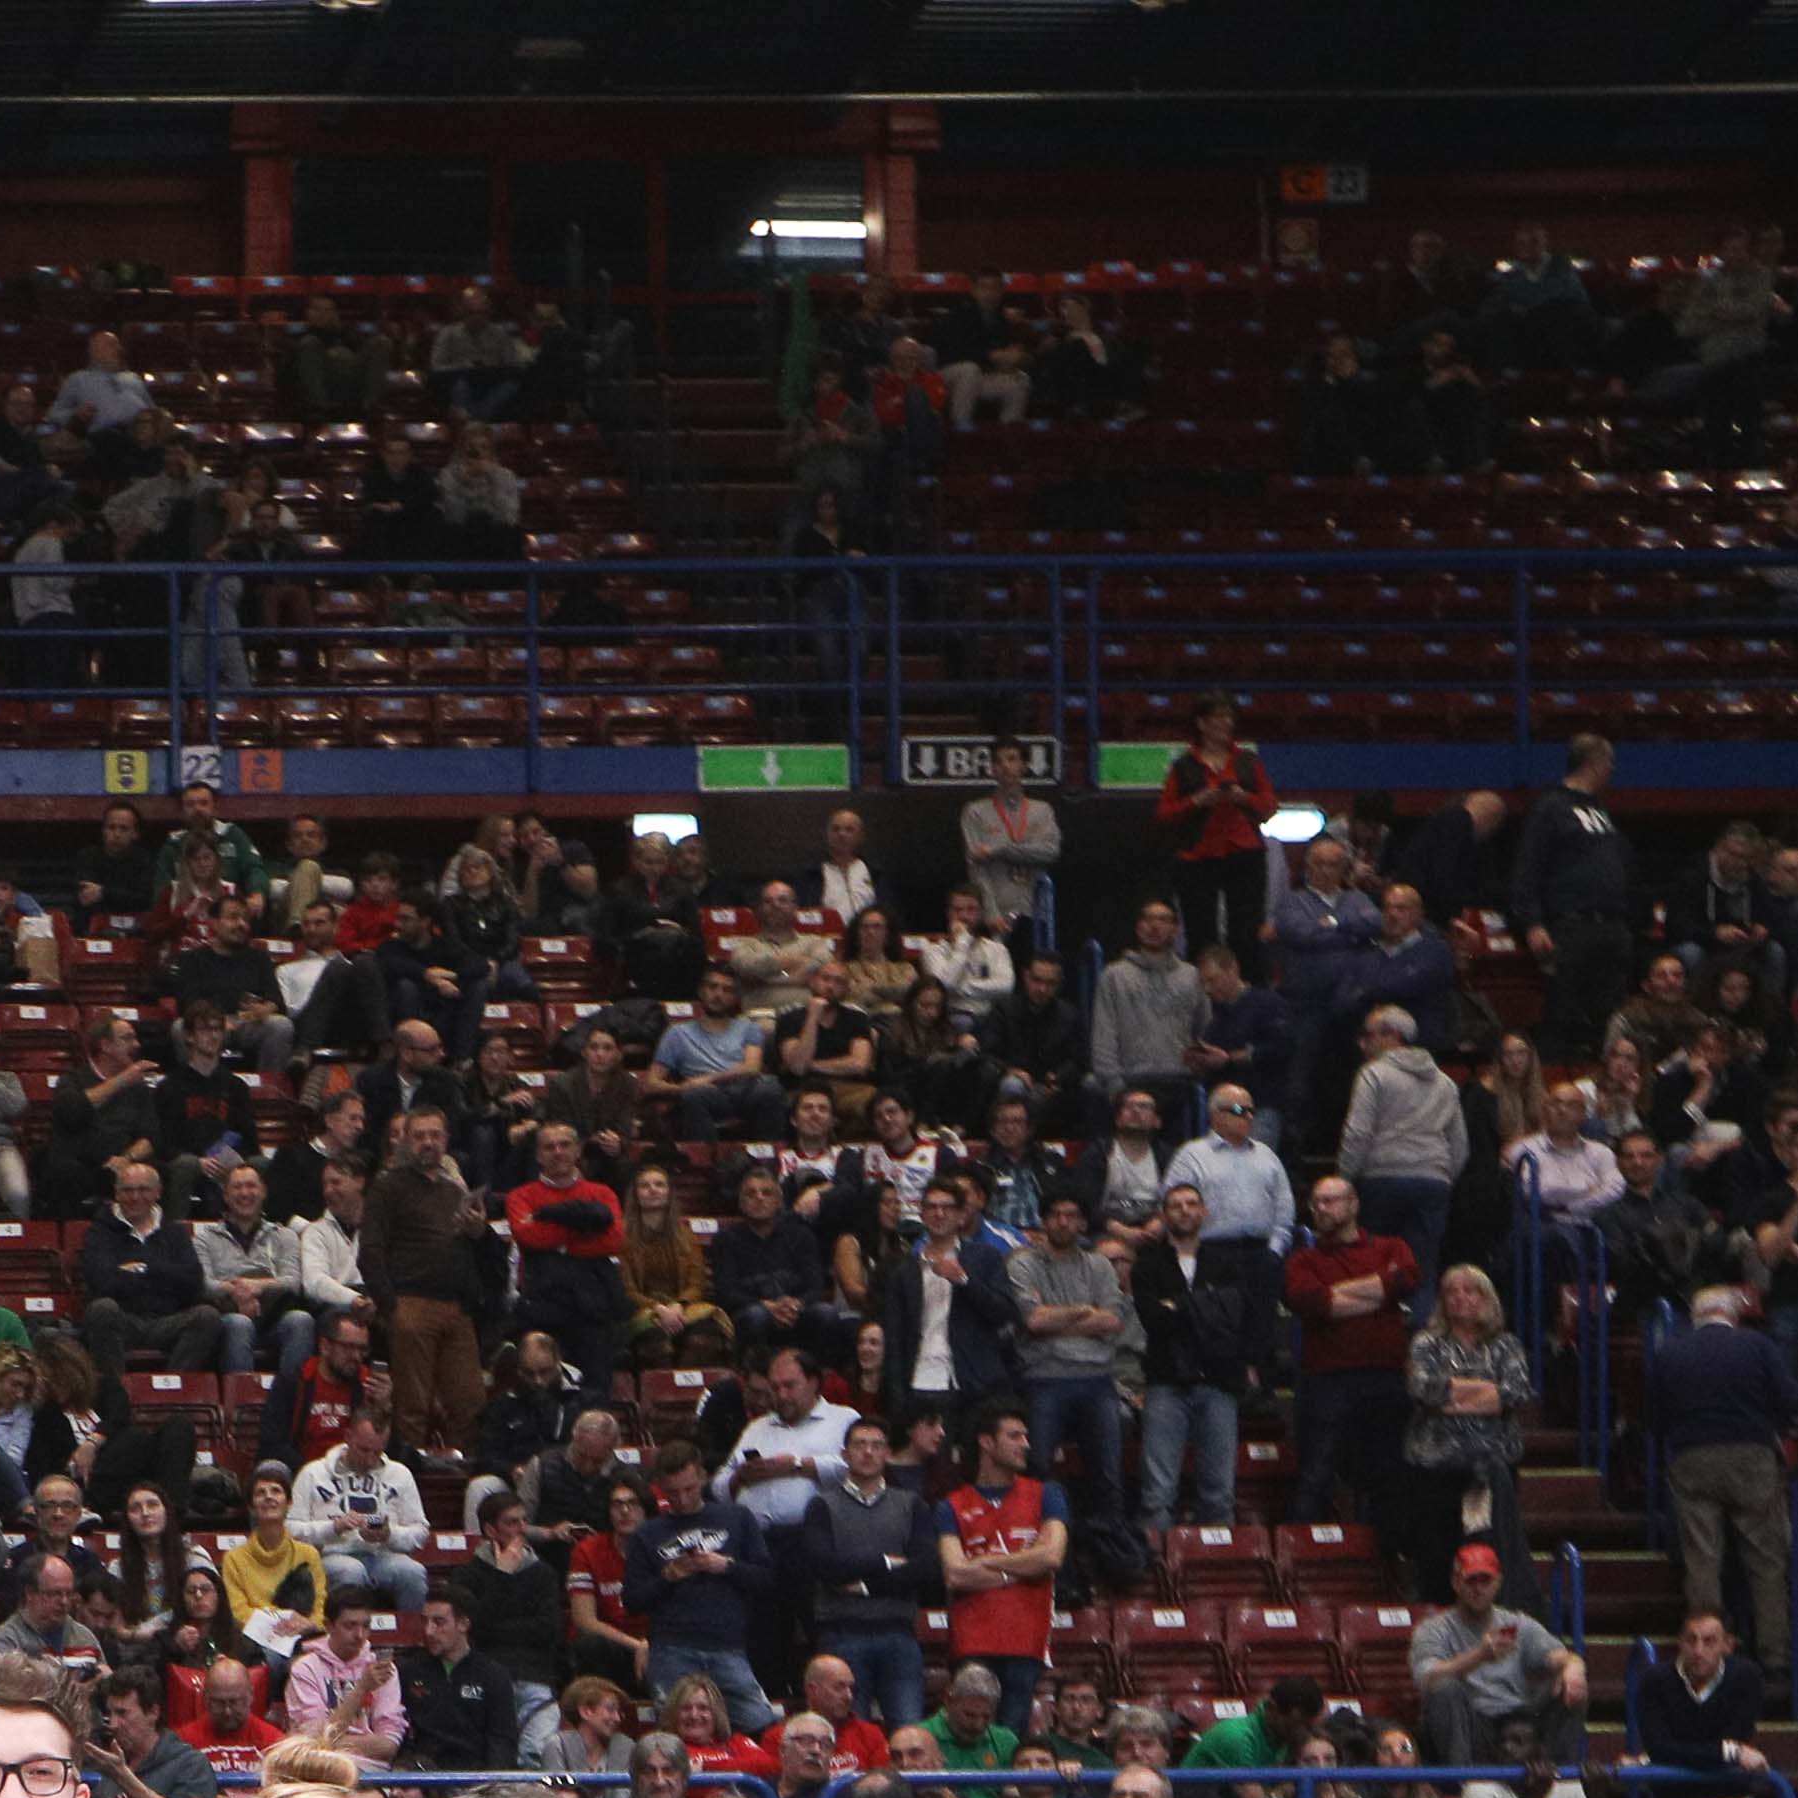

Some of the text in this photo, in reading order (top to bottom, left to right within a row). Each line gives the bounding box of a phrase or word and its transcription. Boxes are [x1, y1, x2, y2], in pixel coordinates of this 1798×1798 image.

[118, 751, 132, 773] B
[182, 751, 220, 780] 22
[946, 745, 997, 777] BA
[254, 767, 269, 788] C
